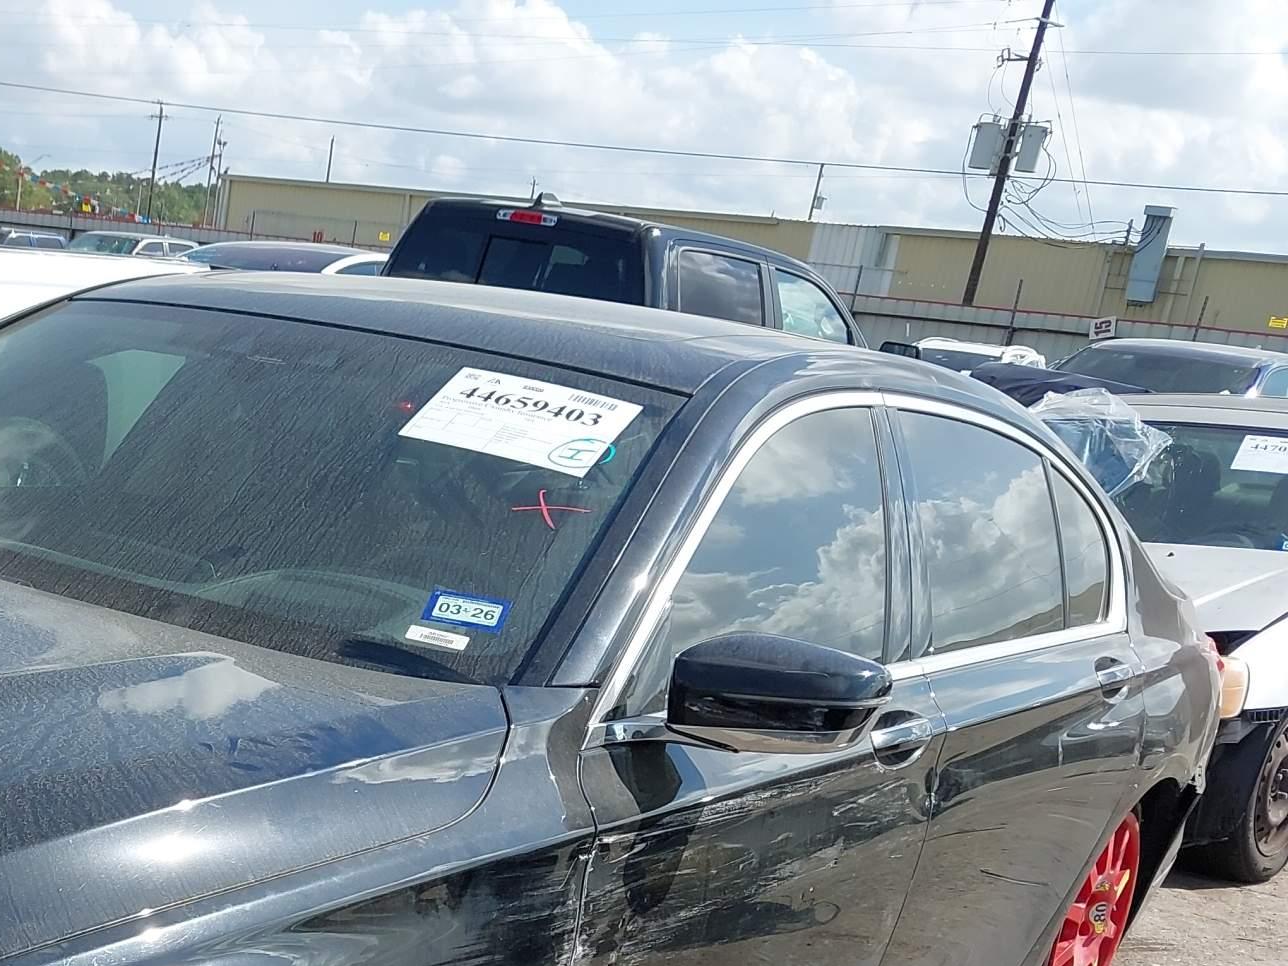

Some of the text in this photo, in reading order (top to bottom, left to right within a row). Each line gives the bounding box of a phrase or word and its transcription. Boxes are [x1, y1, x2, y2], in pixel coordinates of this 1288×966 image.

[1093, 319, 1113, 338] 15
[459, 386, 603, 427] 44659403
[1094, 903, 1107, 922] 80
